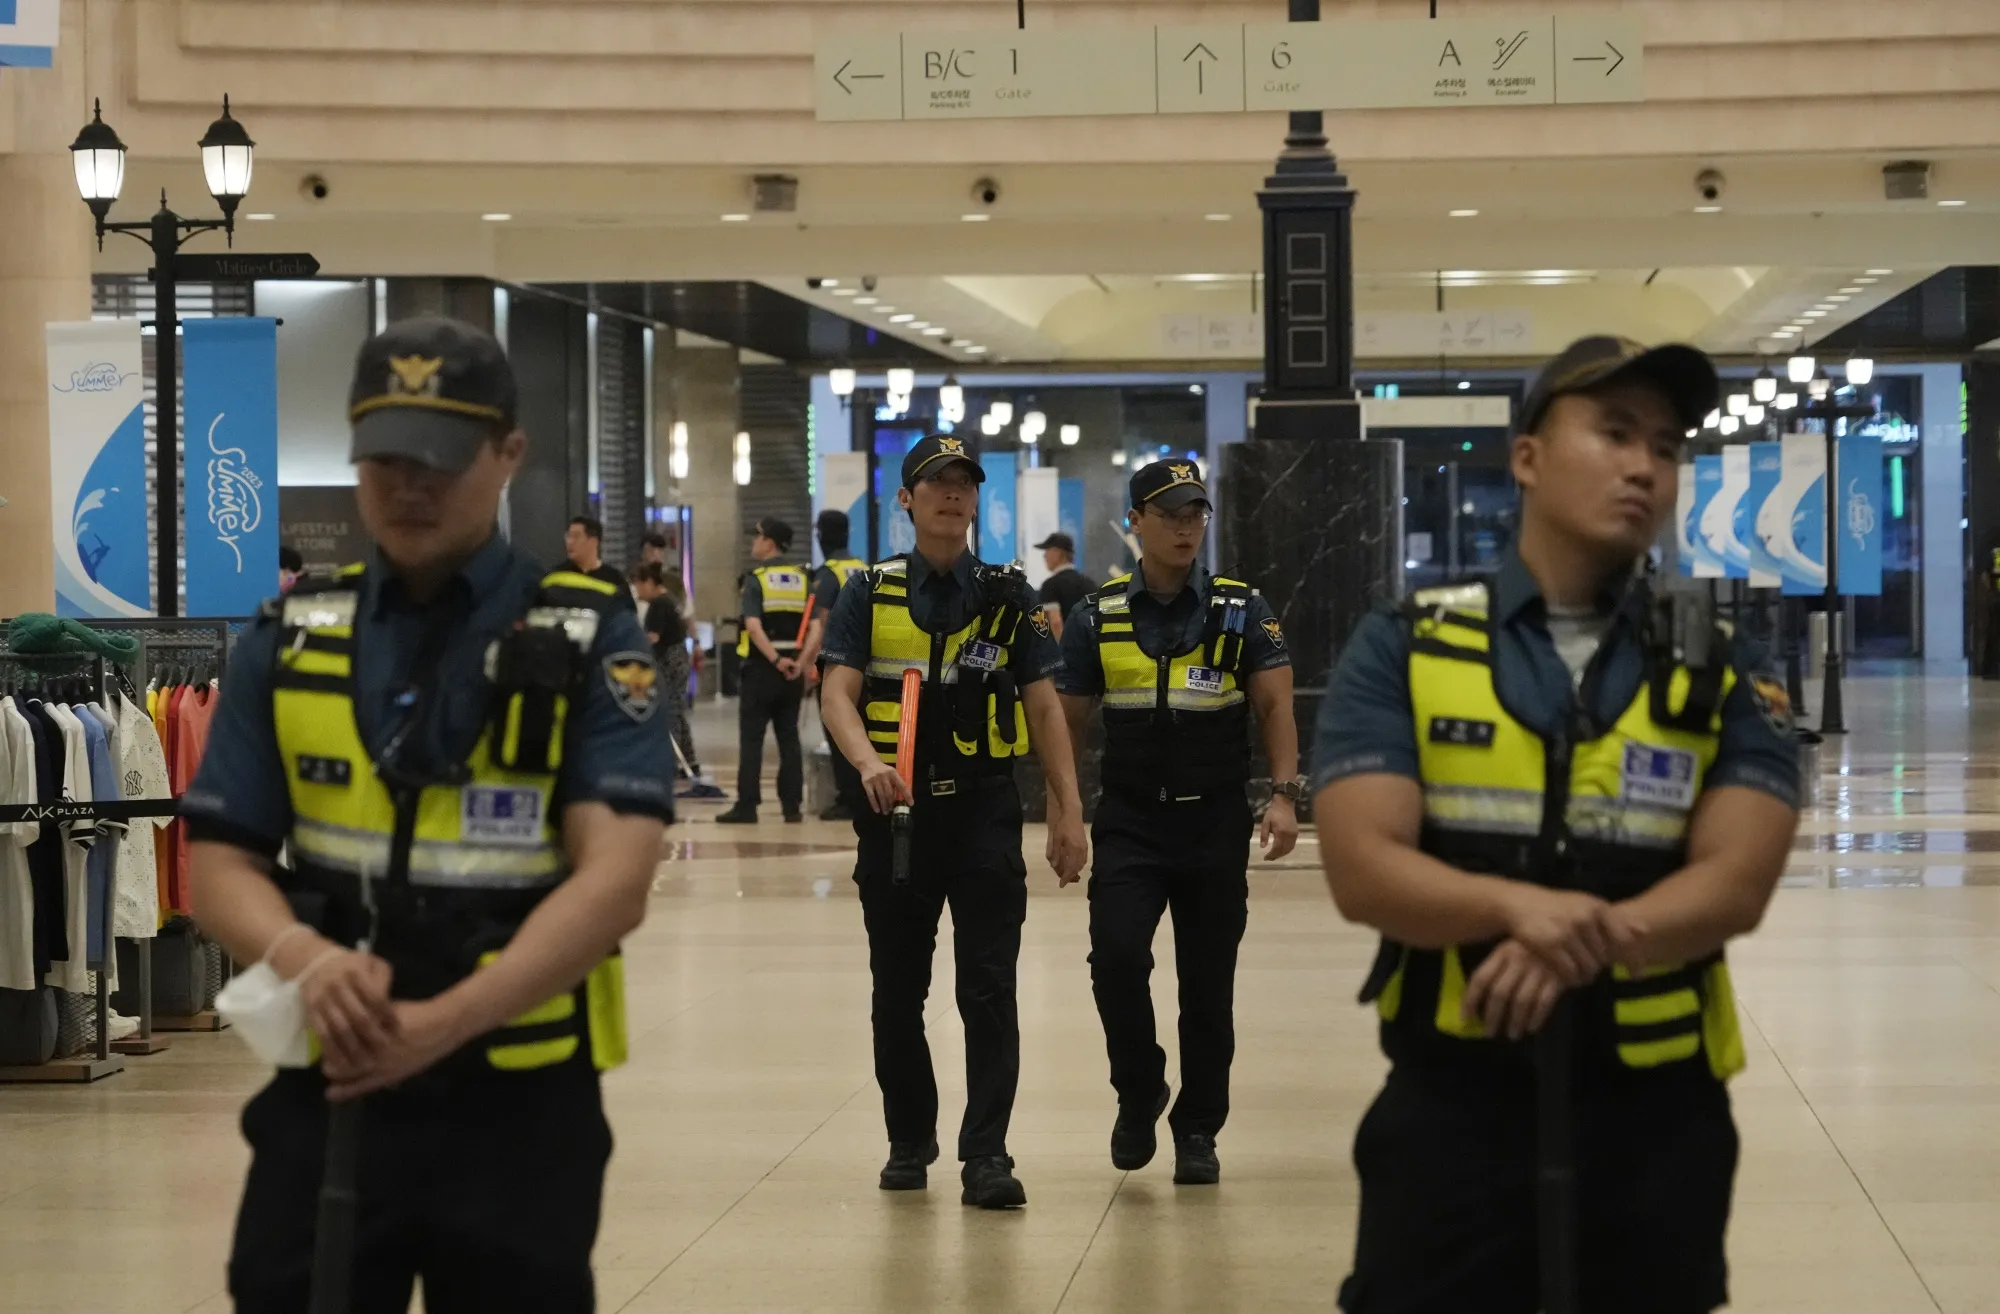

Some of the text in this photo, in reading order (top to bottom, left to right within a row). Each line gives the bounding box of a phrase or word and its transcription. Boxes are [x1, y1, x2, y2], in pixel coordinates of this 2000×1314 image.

[1009, 48, 1018, 75] 1
[1271, 41, 1292, 70] 6
[1438, 39, 1461, 67] A
[924, 48, 976, 81] B/C
[994, 86, 1033, 100] Gate
[1263, 80, 1301, 93] Gate
[215, 258, 309, 275] Matinee Circle
[240, 466, 264, 491] 2023
[964, 656, 993, 669] POLICE
[1190, 681, 1219, 691] POLICE
[21, 806, 95, 820] AK PLAZA
